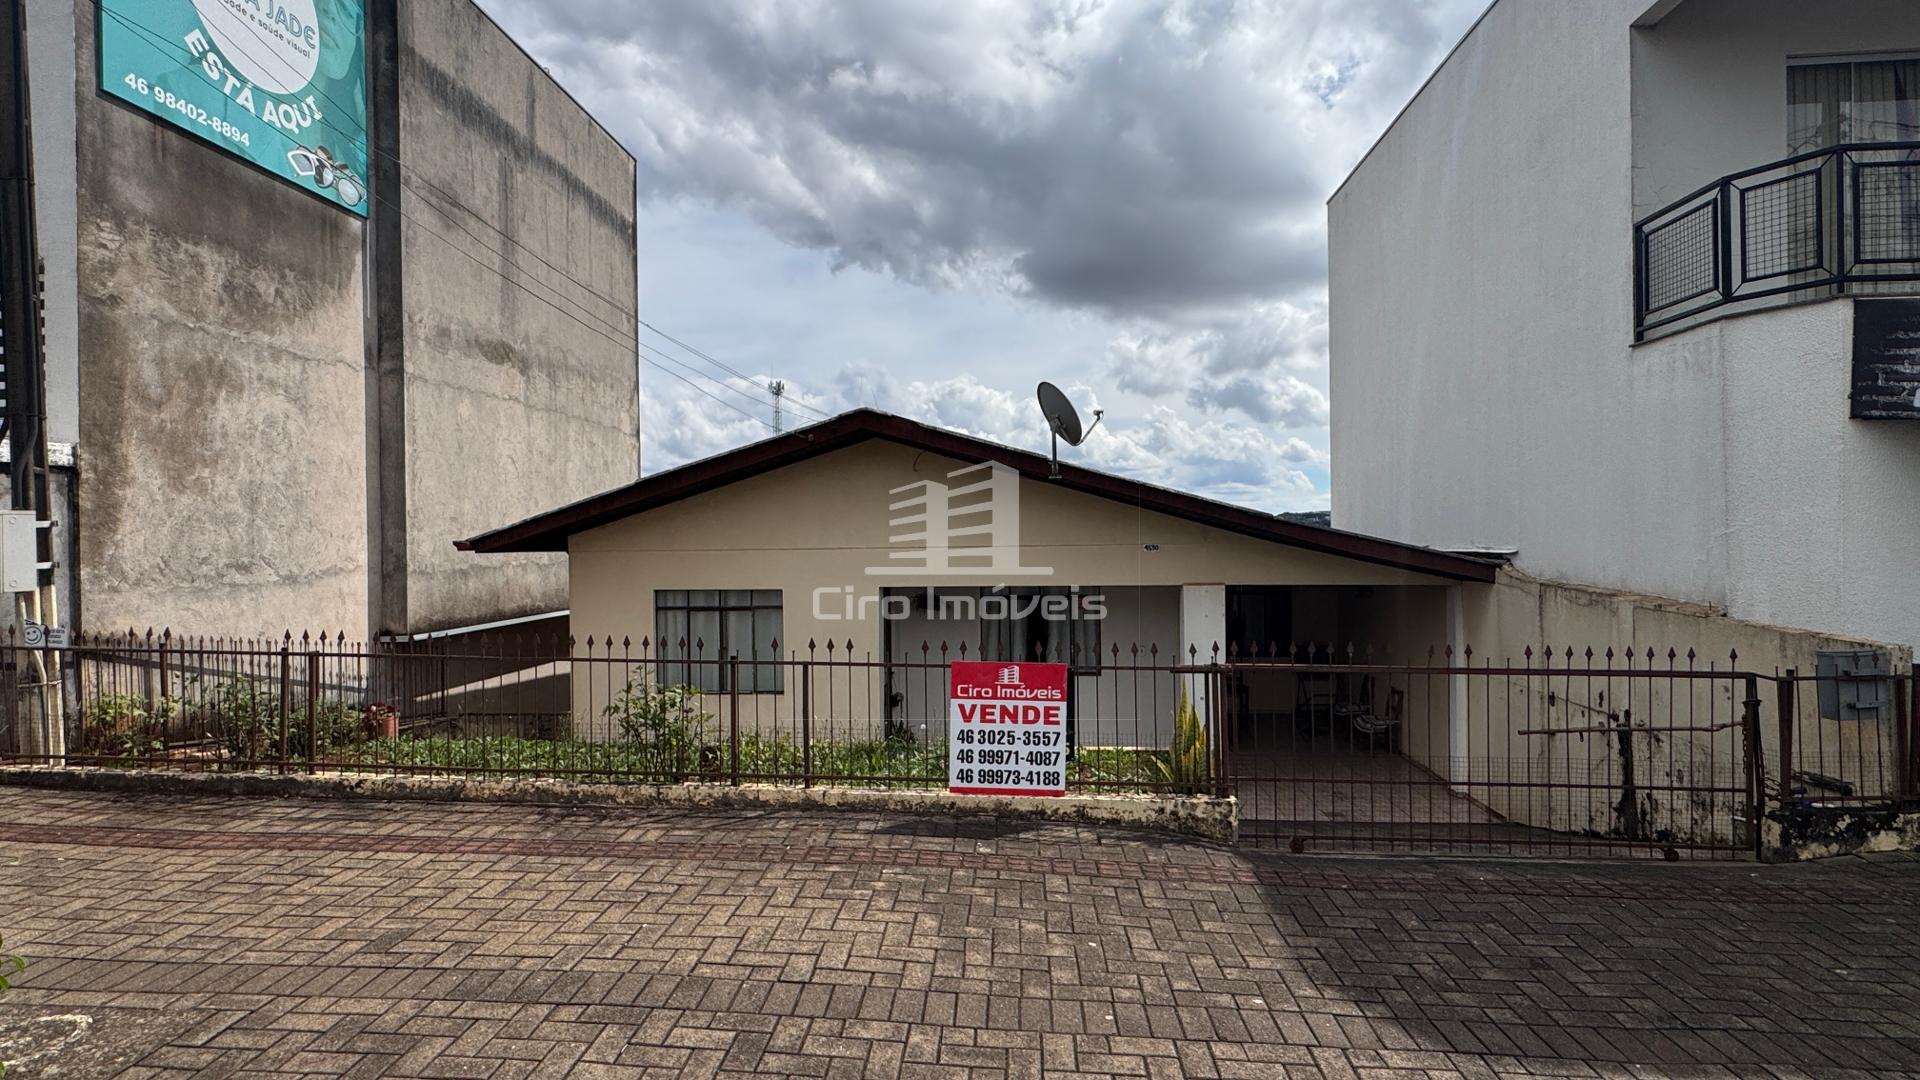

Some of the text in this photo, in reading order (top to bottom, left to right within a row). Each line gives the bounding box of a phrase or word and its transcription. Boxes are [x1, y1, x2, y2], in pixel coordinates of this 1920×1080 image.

[249, 13, 256, 22] e
[258, 19, 284, 41] saúde
[286, 37, 311, 59] visual
[266, 0, 316, 50] JADE
[184, 28, 256, 116] ESTÁ
[124, 72, 250, 147] 46 98402-8894
[957, 684, 1062, 699] Ciro Imóveis
[957, 703, 1061, 726] VENDE
[956, 729, 1061, 747] 46 3025-3557
[956, 748, 1061, 767] 46 99971-4087
[956, 768, 1061, 786] 46 99973-4188
